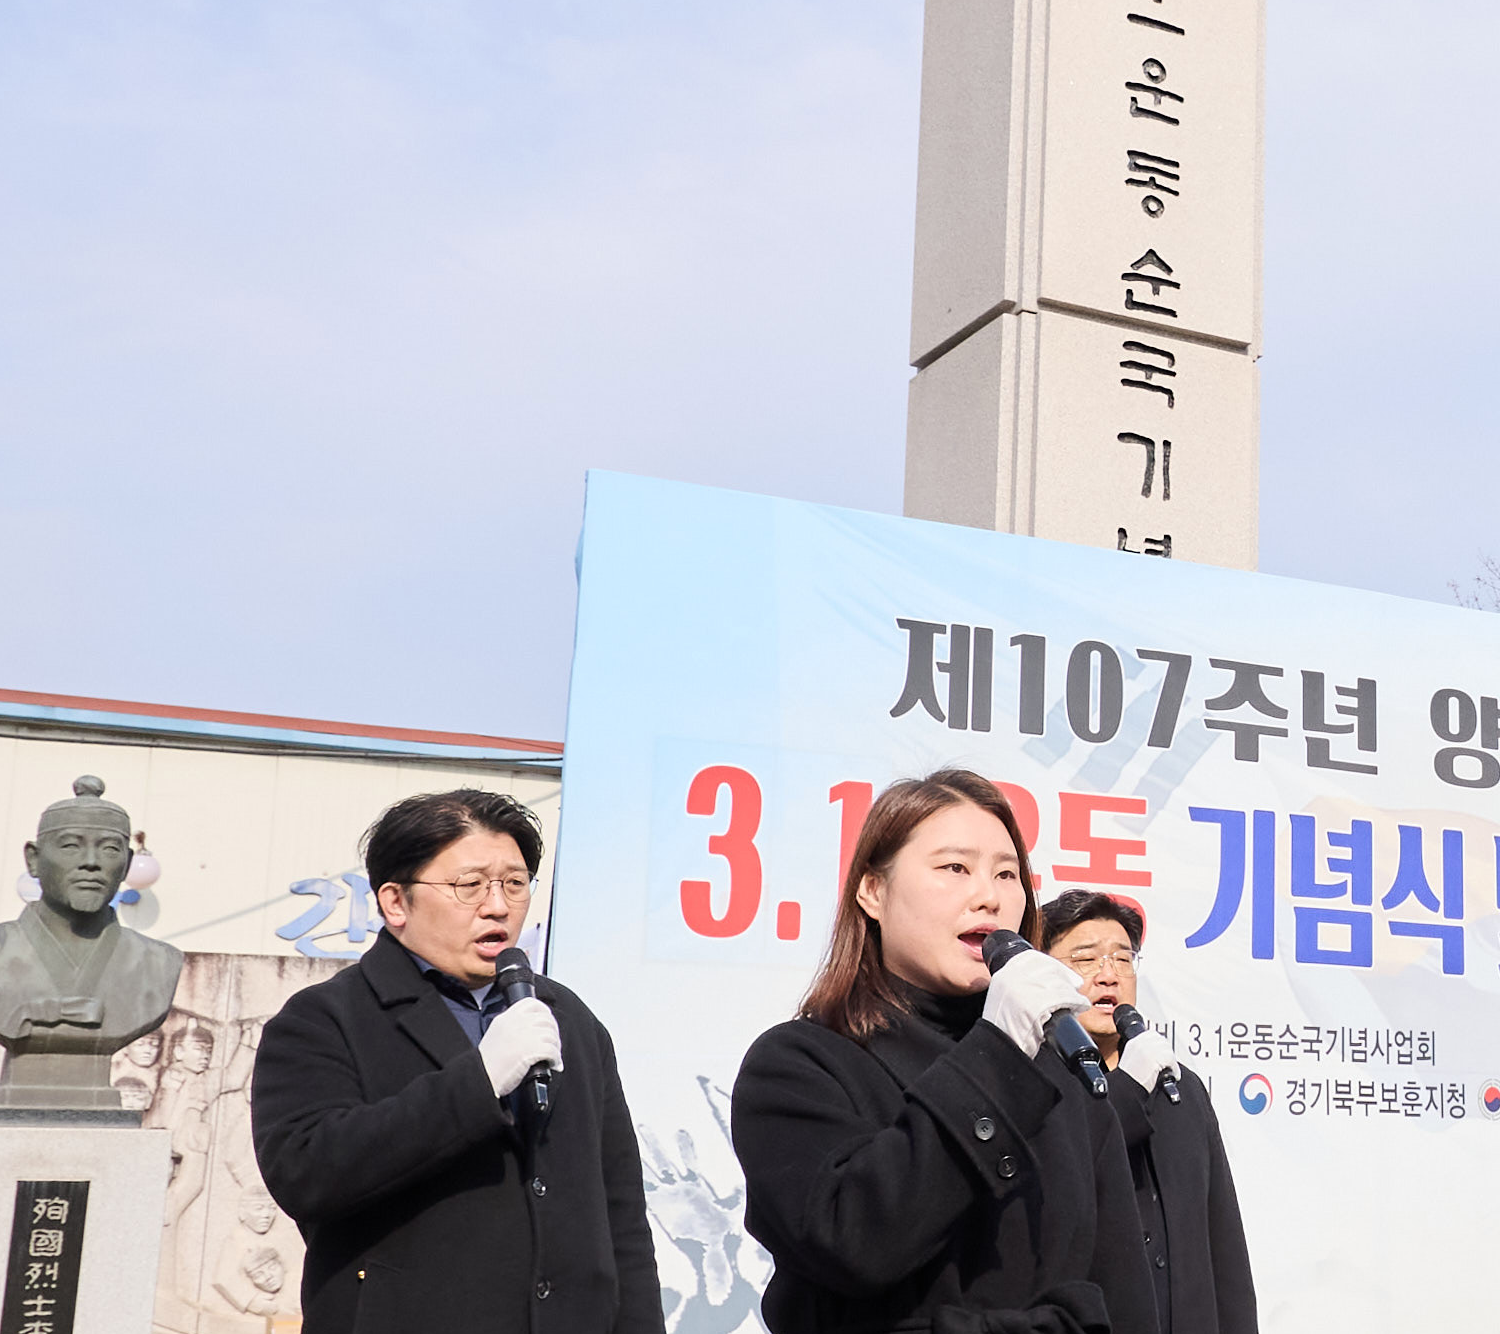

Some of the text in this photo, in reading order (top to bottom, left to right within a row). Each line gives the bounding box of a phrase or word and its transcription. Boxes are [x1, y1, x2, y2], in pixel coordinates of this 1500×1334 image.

[888, 616, 1380, 776] 제107주년
[679, 764, 1153, 945] 3.1동
[1184, 805, 1465, 976] 기념식
[1187, 1021, 1437, 1067] 3.1운동순국기념사업회
[1284, 1077, 1467, 1121] 경기북부보훈지청
